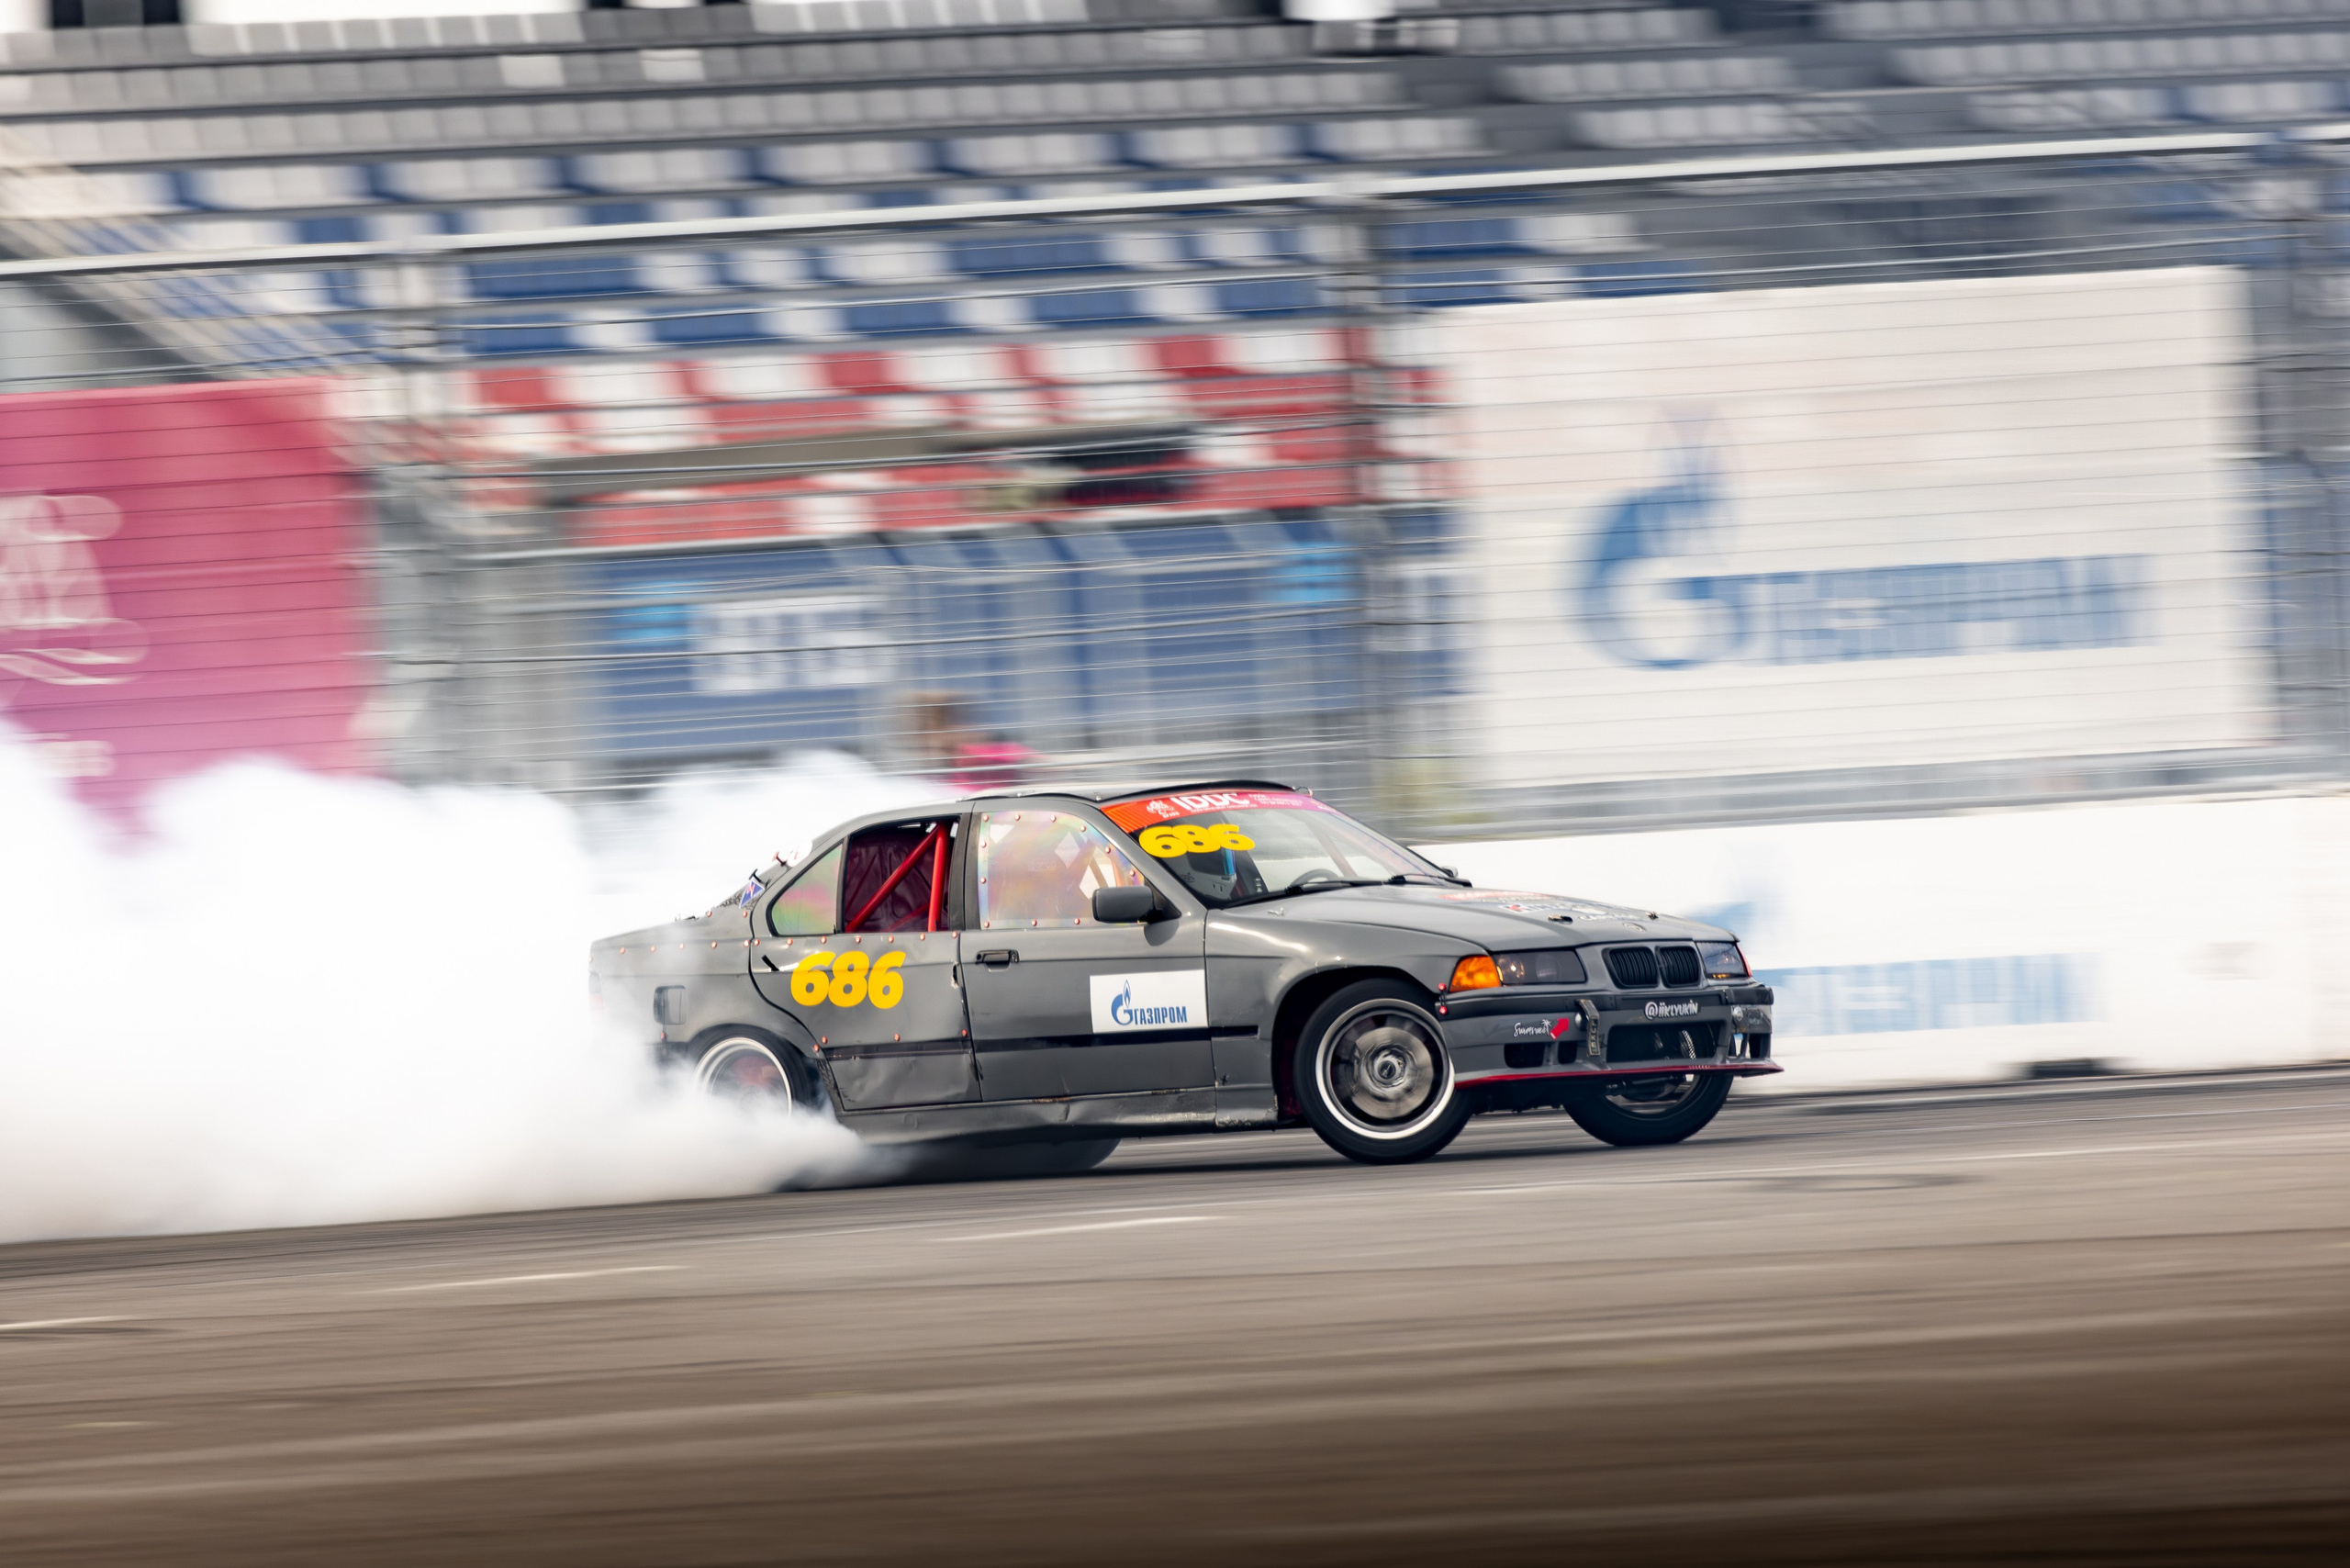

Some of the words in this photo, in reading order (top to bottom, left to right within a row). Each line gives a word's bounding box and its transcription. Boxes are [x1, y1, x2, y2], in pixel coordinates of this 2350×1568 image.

[1169, 793, 1250, 811] IDDC
[1138, 823, 1255, 858] 686
[790, 950, 906, 1009] 686
[1134, 1006, 1188, 1025] ГАЗПРОМ
